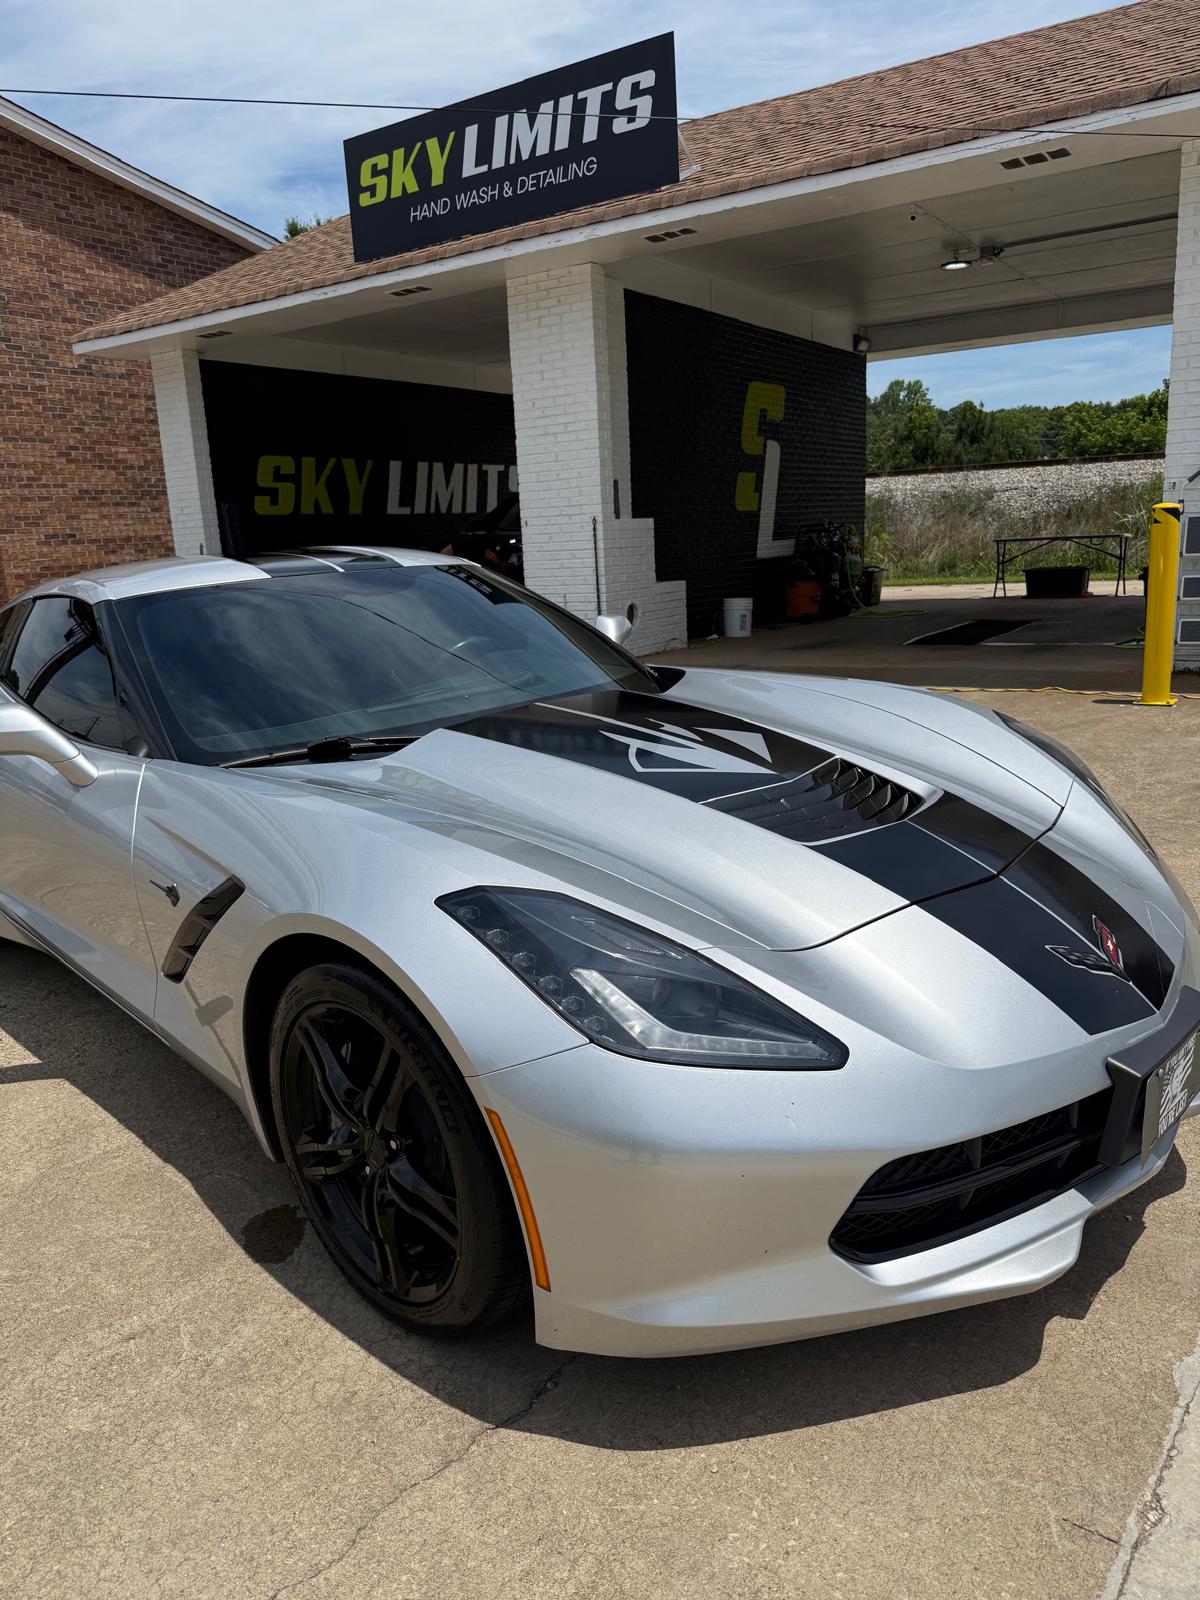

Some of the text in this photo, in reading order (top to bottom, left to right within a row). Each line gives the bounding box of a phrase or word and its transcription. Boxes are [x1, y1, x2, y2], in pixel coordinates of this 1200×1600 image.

[359, 69, 656, 207] SKY LIMITS
[410, 156, 598, 223] HAND WASH & DETAILING
[254, 455, 373, 515] SKY
